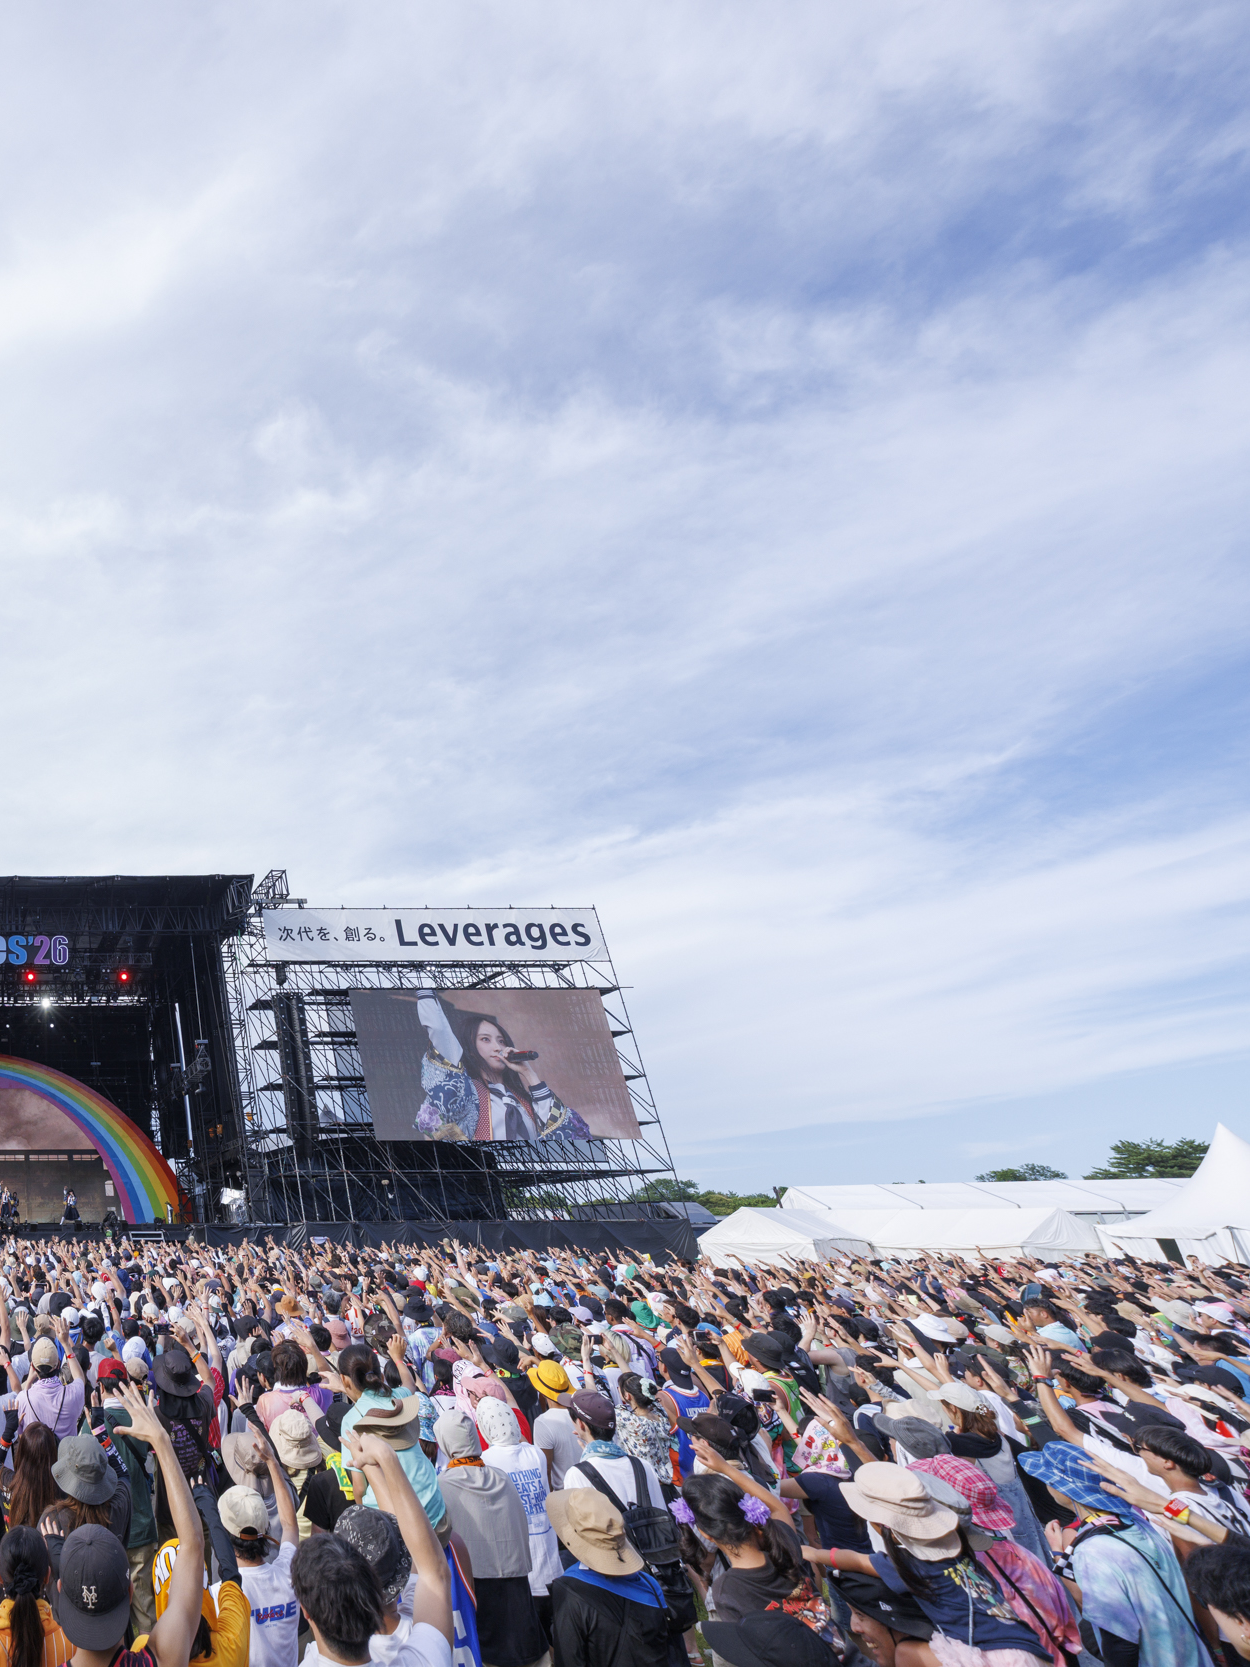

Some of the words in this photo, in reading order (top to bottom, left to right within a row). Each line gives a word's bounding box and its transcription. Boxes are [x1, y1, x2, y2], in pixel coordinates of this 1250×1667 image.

[278, 926, 386, 943] 次代を、創る。
[394, 919, 592, 950] Leverages
[514, 1481, 537, 1494] EATS
